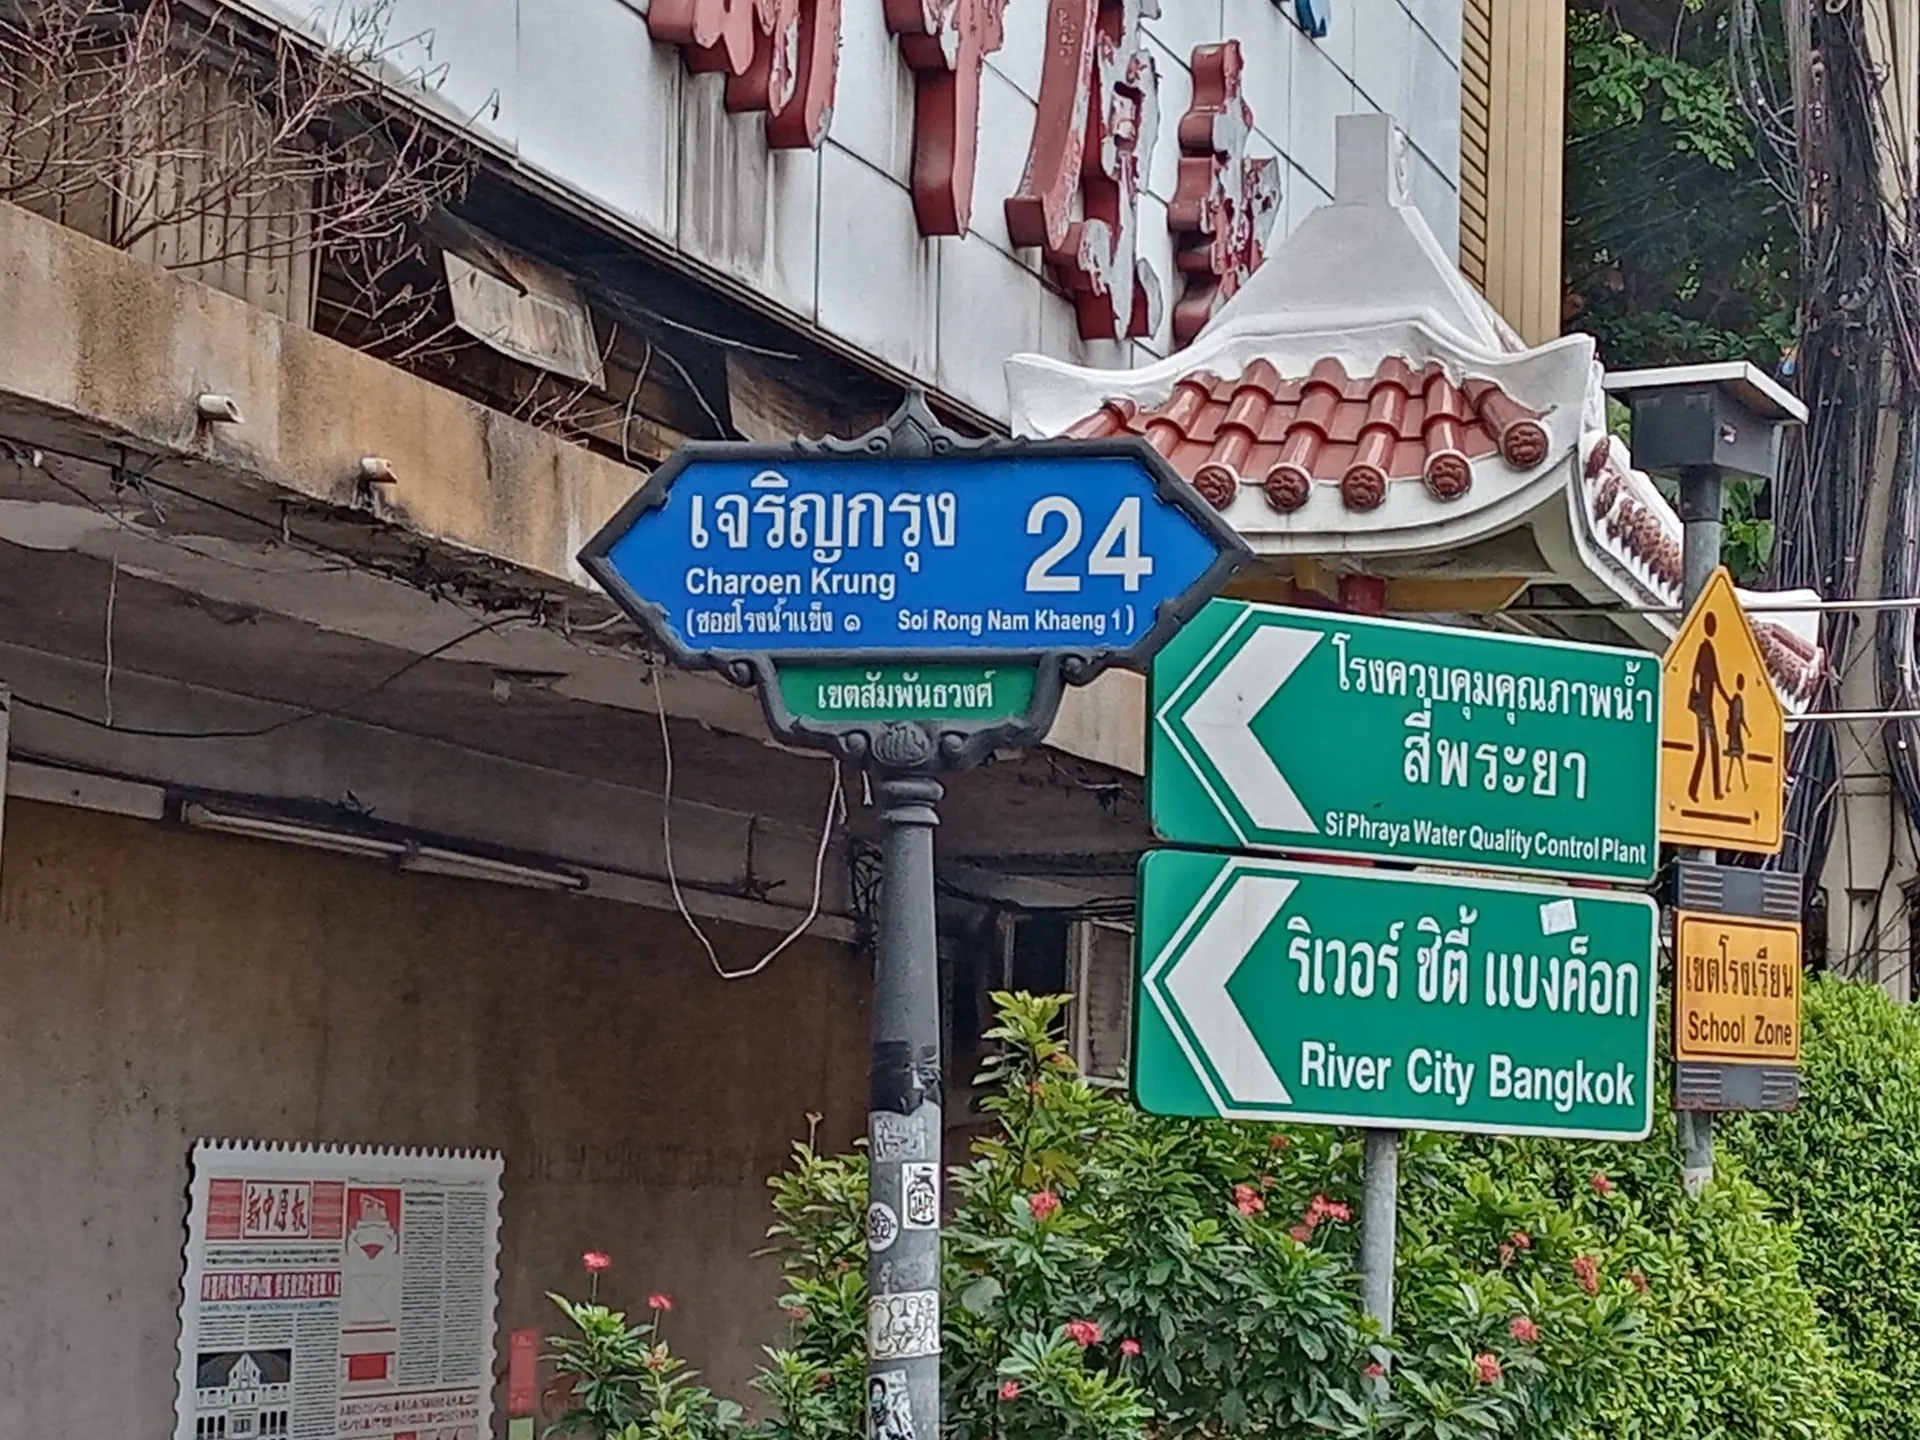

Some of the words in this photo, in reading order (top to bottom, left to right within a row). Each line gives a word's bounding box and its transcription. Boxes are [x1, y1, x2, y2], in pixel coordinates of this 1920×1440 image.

[689, 470, 956, 573] เจริญกรุง
[1025, 495, 1154, 593] 24
[685, 568, 802, 596] Charoen
[810, 569, 896, 600] Krung
[898, 611, 929, 631] Soi
[934, 611, 982, 635] Rong
[988, 612, 1030, 631] Nam
[1035, 612, 1105, 636] Khaeng
[817, 671, 996, 710] เขตสัมพันธวงศ์
[1331, 632, 1655, 729] โรงควบคุมคุณภาพน้ำ
[1402, 698, 1588, 800] สี่พระยา
[1325, 811, 1344, 835] Si
[1346, 814, 1411, 847] Phraya
[1413, 820, 1467, 848] Water
[1469, 826, 1532, 859] Quality
[1534, 832, 1600, 859] Control
[1601, 838, 1648, 865] Plant
[1288, 915, 1404, 1000] ริเวอร์
[1417, 904, 1478, 1005] ซิตี้
[1486, 936, 1639, 1018] แบงค็อก
[1685, 934, 1795, 999] เขตโรงเรียน
[1687, 1011, 1747, 1045] School
[1754, 1015, 1793, 1047] Zone
[1300, 1041, 1393, 1092] River
[1406, 1047, 1475, 1105] City
[1489, 1056, 1636, 1113] Bangkok
